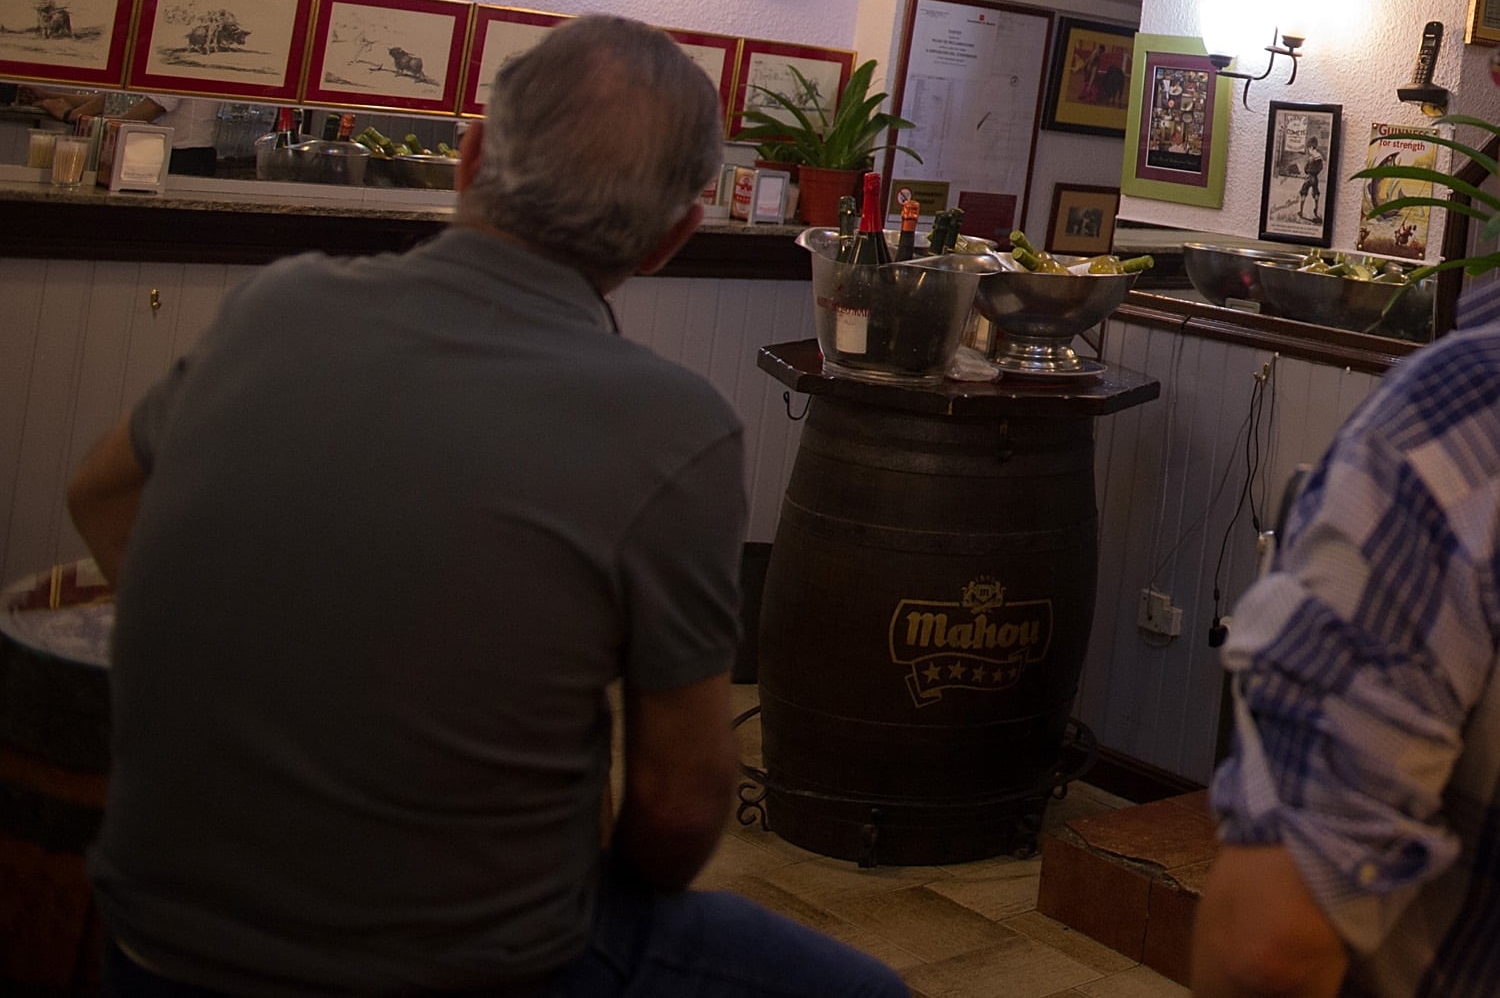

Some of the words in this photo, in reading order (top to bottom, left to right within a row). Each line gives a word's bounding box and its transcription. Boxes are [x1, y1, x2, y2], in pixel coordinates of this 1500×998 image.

[1378, 124, 1430, 136] GUINNESS
[1392, 140, 1426, 152] strength
[906, 610, 1040, 650] Mahou
